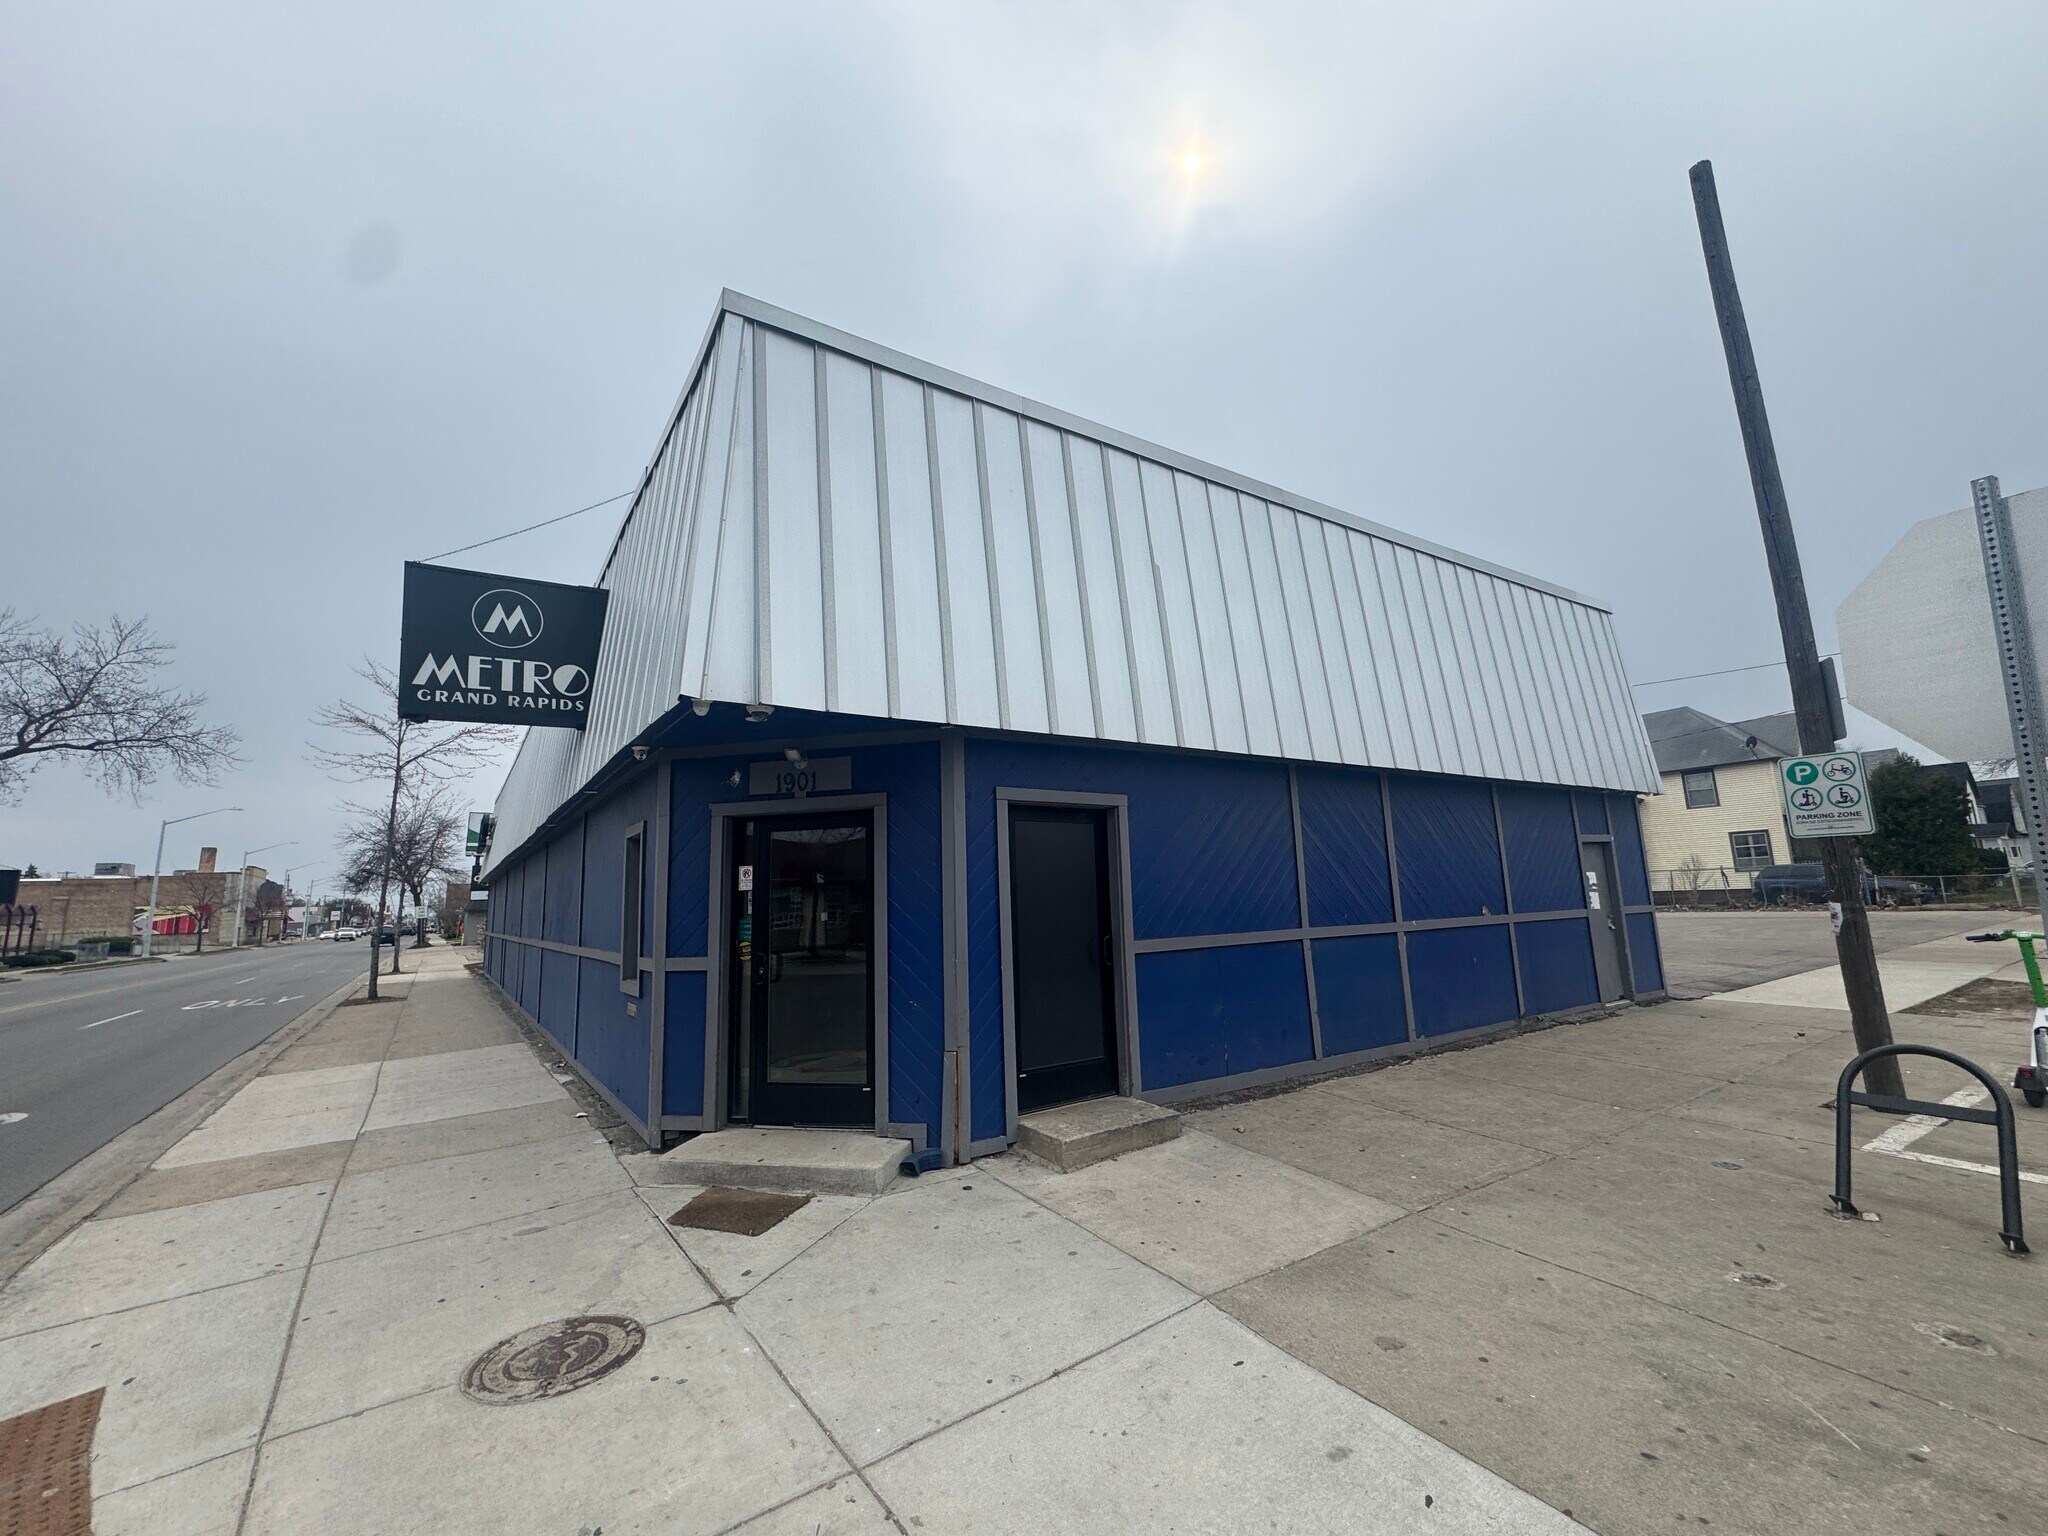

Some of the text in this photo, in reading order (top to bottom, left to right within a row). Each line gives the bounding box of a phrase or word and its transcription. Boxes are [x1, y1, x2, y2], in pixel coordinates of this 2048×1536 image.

[482, 602, 533, 638] M
[411, 652, 590, 698] METRO
[416, 688, 585, 712] GRAND RAPIDS
[776, 771, 817, 793] 1901
[1794, 764, 1812, 782] P
[1795, 812, 1835, 821] PARKING
[1836, 810, 1863, 818] ZONE
[181, 995, 305, 1011] ONLY
